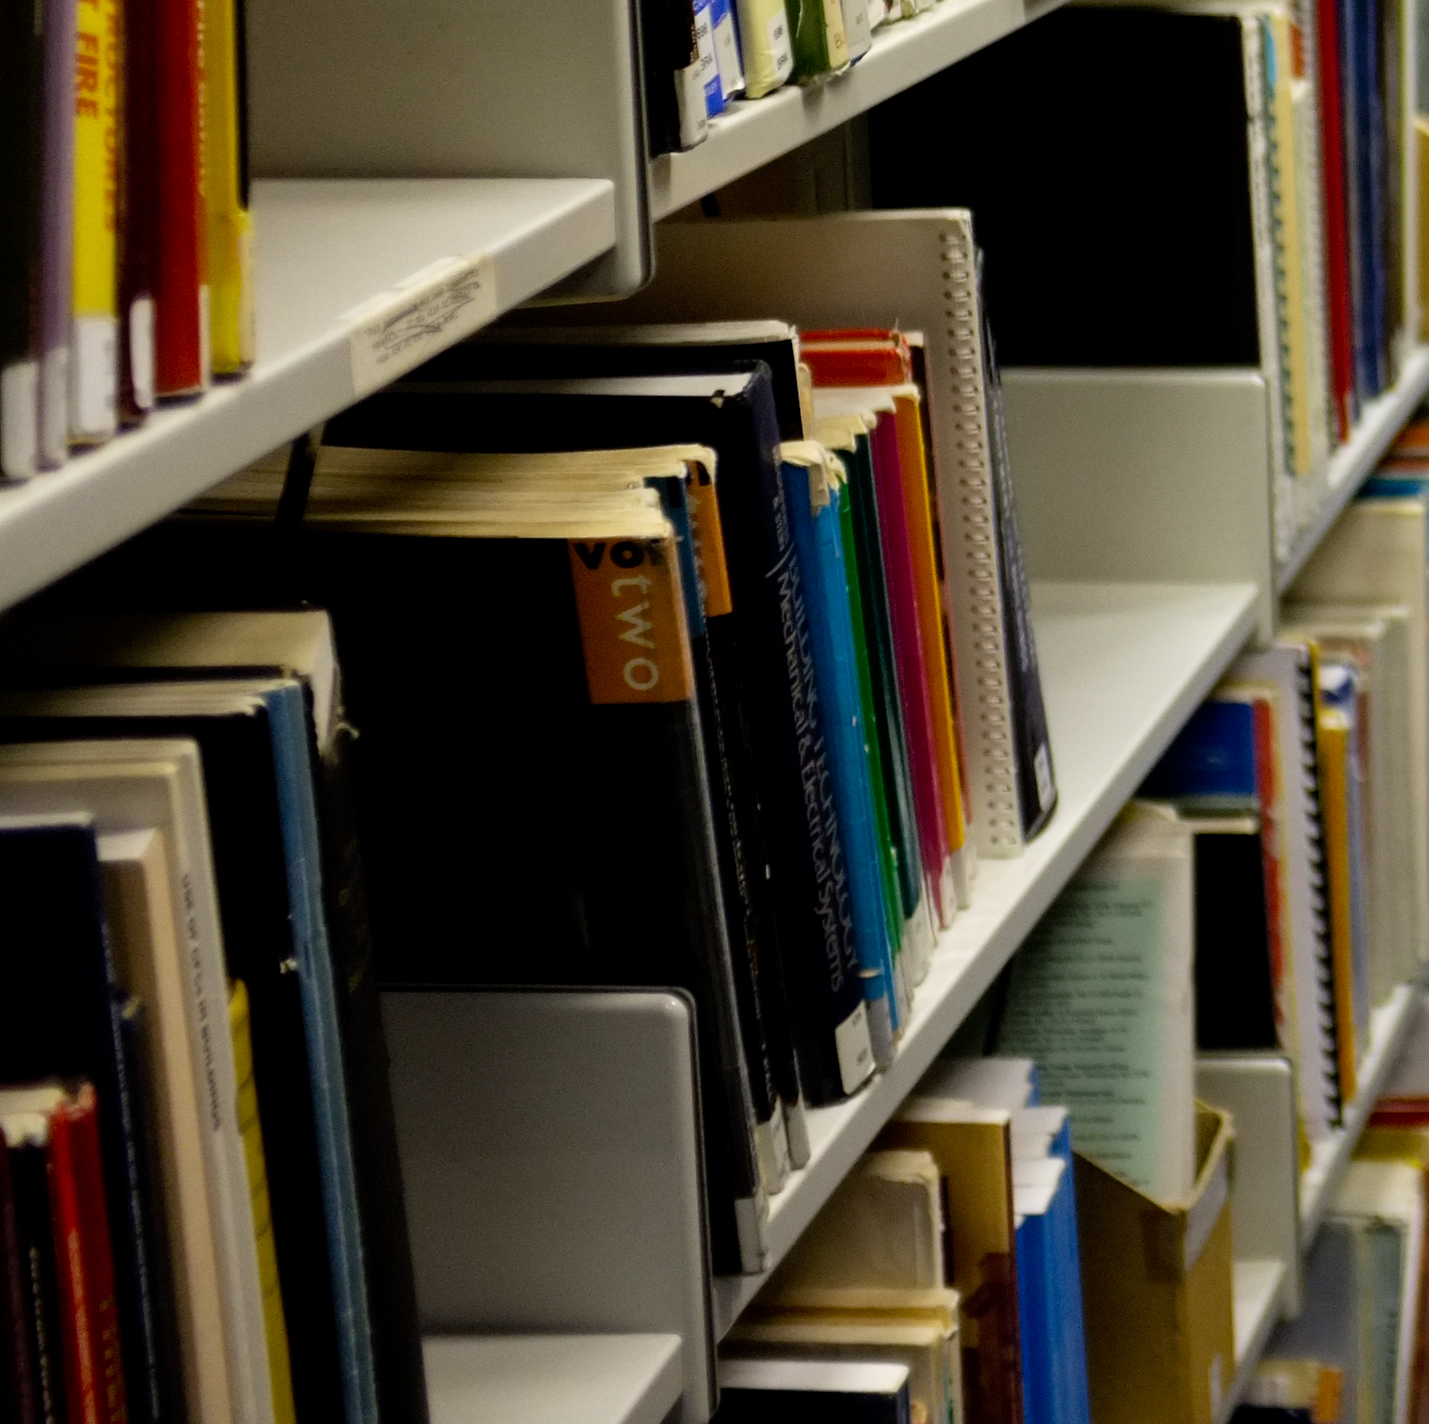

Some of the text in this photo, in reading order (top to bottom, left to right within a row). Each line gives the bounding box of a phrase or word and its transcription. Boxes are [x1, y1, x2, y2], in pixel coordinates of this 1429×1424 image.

[74, 30, 98, 119] FIRE
[609, 574, 661, 693] two
[777, 567, 846, 993] Mechanical & Electrical Systems
